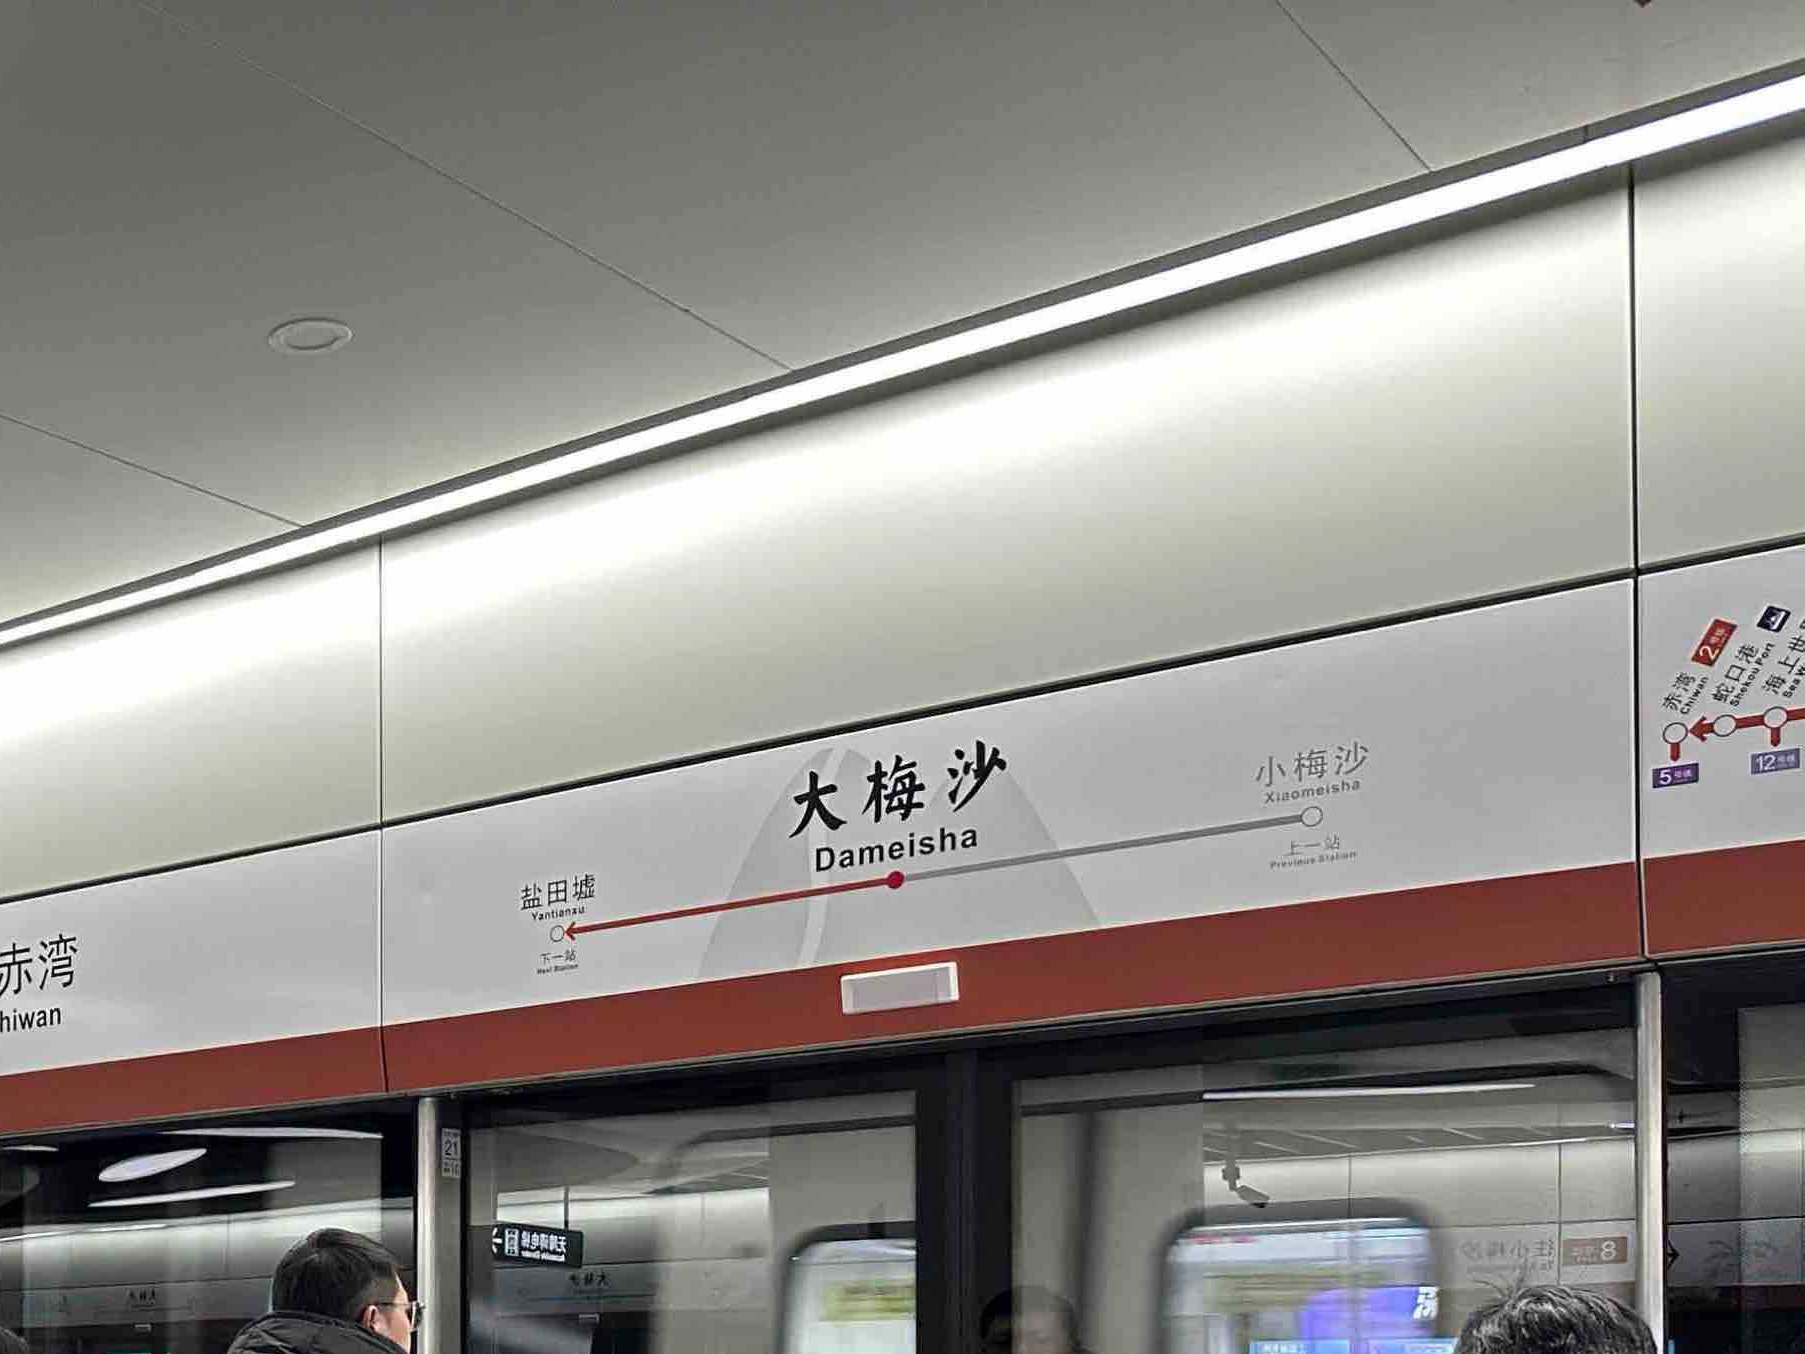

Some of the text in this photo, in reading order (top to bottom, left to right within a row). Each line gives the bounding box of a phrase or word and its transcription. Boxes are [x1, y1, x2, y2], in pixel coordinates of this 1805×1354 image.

[1762, 617, 1805, 694] 海上世
[1680, 676, 1709, 714] Chiwan
[1255, 741, 1369, 788] 小梅沙
[789, 740, 1007, 838] 大梅沙
[1264, 780, 1361, 804] Xiaomeisha
[815, 827, 978, 872] Dameisha
[1283, 834, 1340, 857] 上一站
[521, 873, 596, 911] 盐田墟
